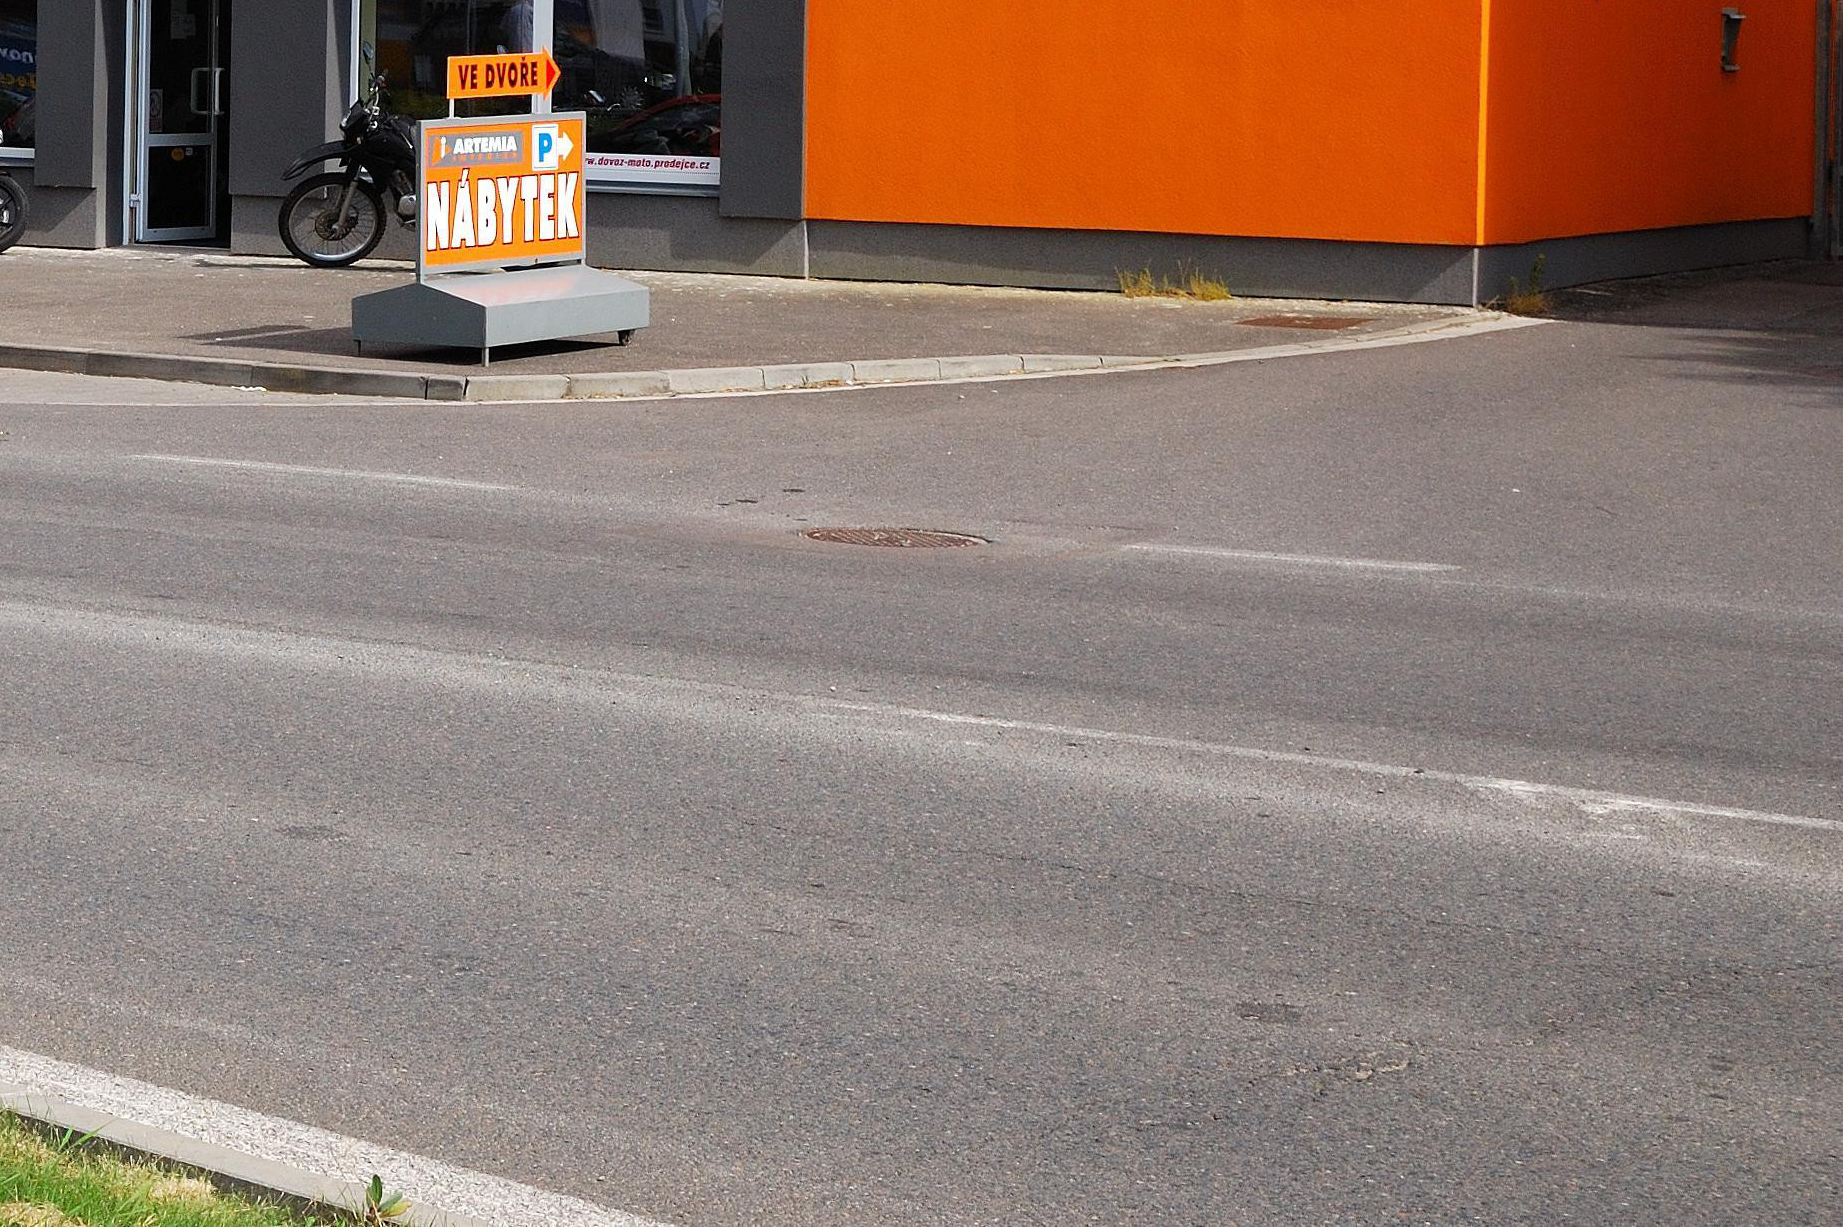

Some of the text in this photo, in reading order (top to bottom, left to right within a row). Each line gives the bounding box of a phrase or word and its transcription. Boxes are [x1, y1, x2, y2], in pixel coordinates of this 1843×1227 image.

[459, 57, 538, 90] VE DVOŘE
[453, 136, 517, 154] ARTEMIA
[539, 133, 552, 162] P
[427, 167, 579, 252] NÁBYTEK
